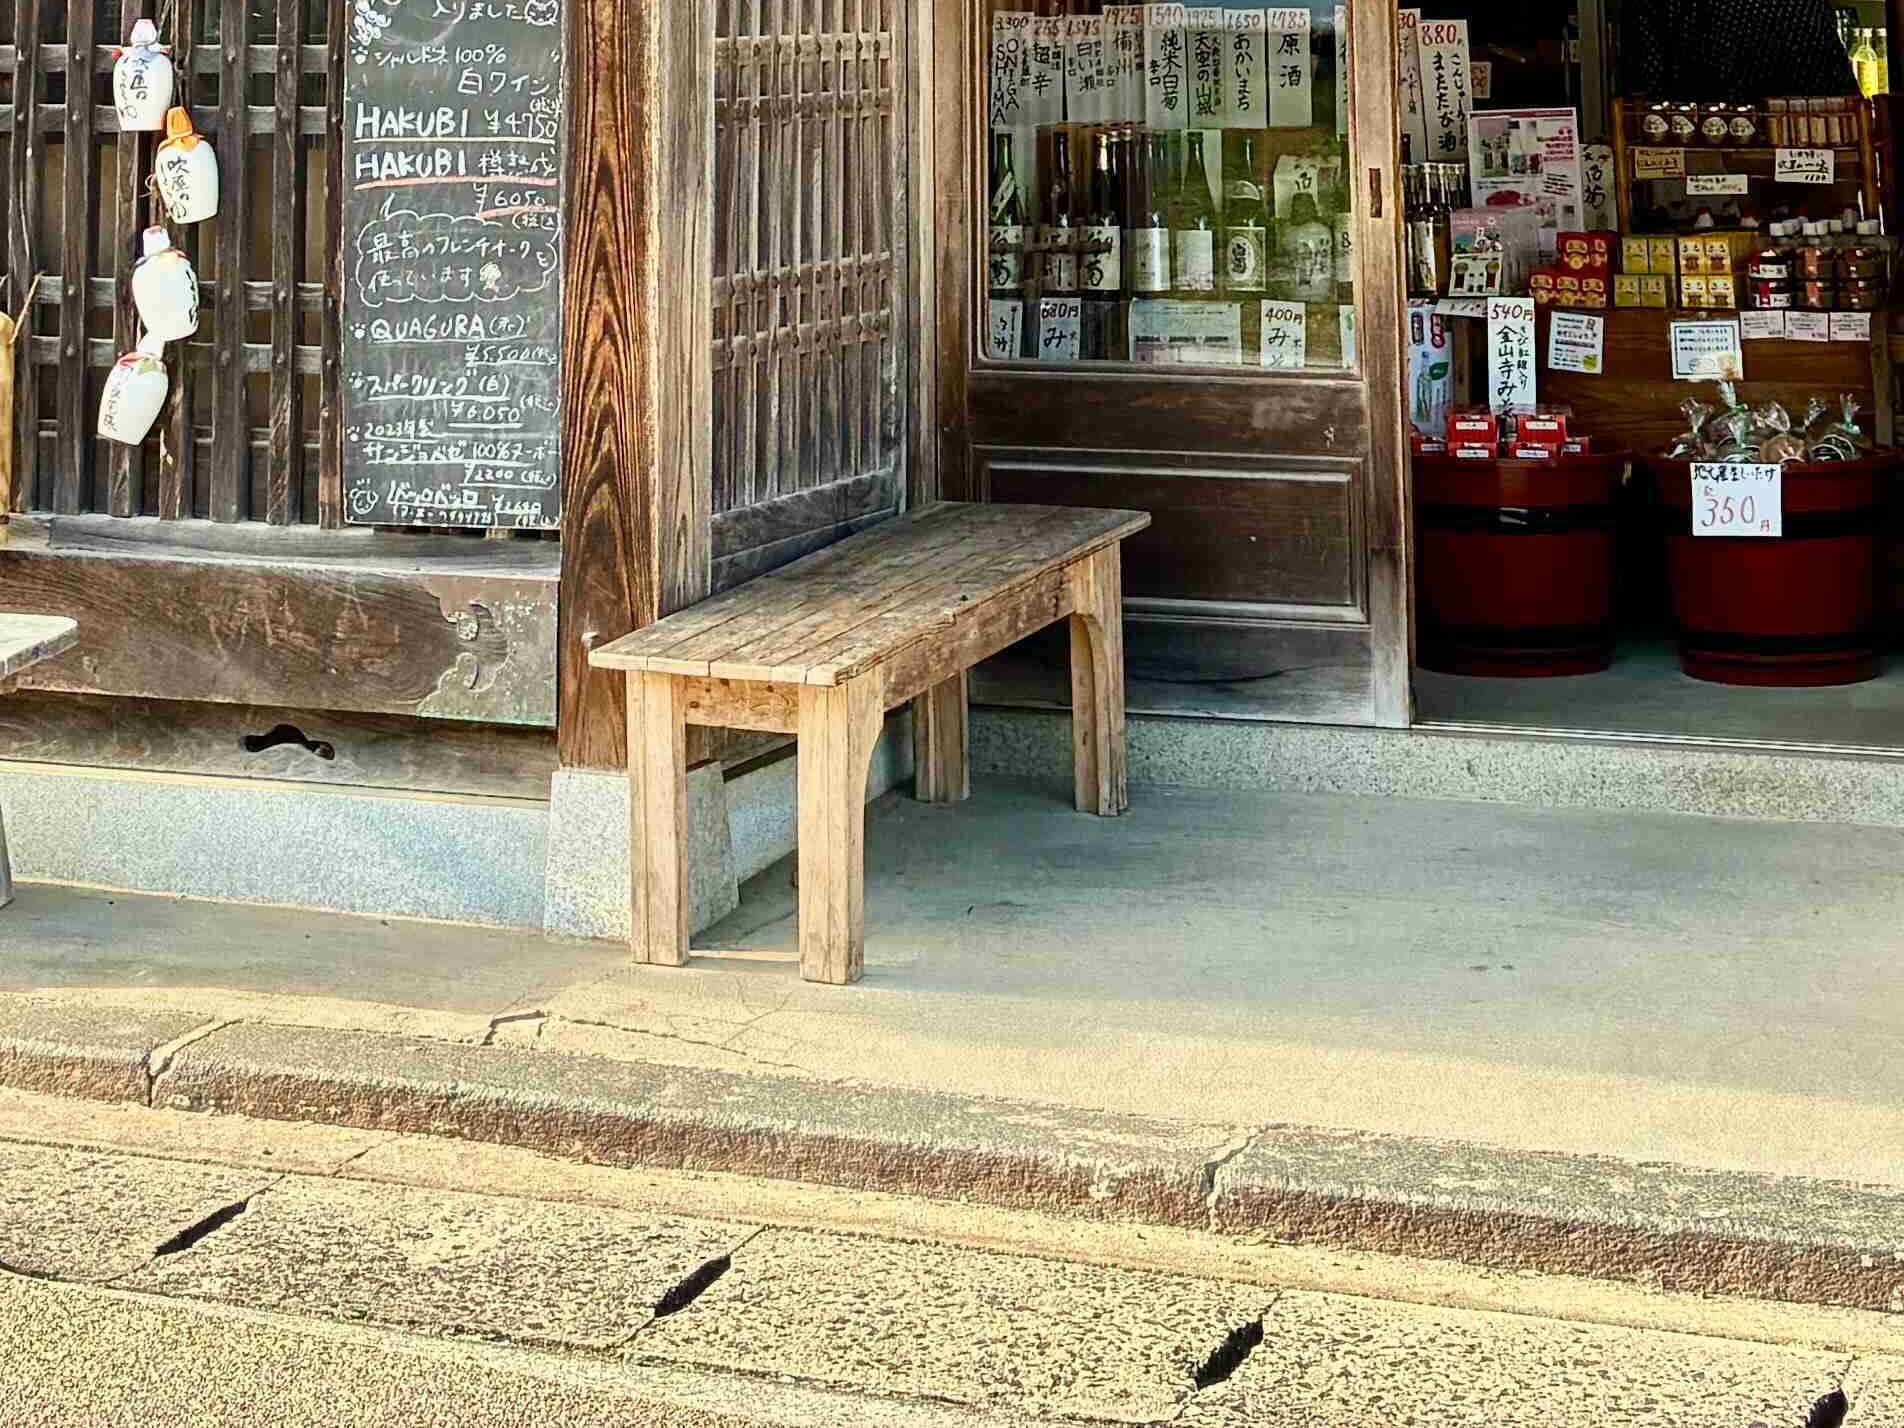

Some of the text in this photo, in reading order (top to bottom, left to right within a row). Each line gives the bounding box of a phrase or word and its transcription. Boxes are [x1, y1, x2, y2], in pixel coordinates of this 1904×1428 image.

[455, 45, 506, 64] 100%
[1278, 34, 1302, 88] 原酒
[458, 66, 550, 95] 白ワイン
[355, 104, 467, 138] HAKUBI
[355, 149, 466, 179] HAKUBI
[1491, 304, 1533, 321] 540円
